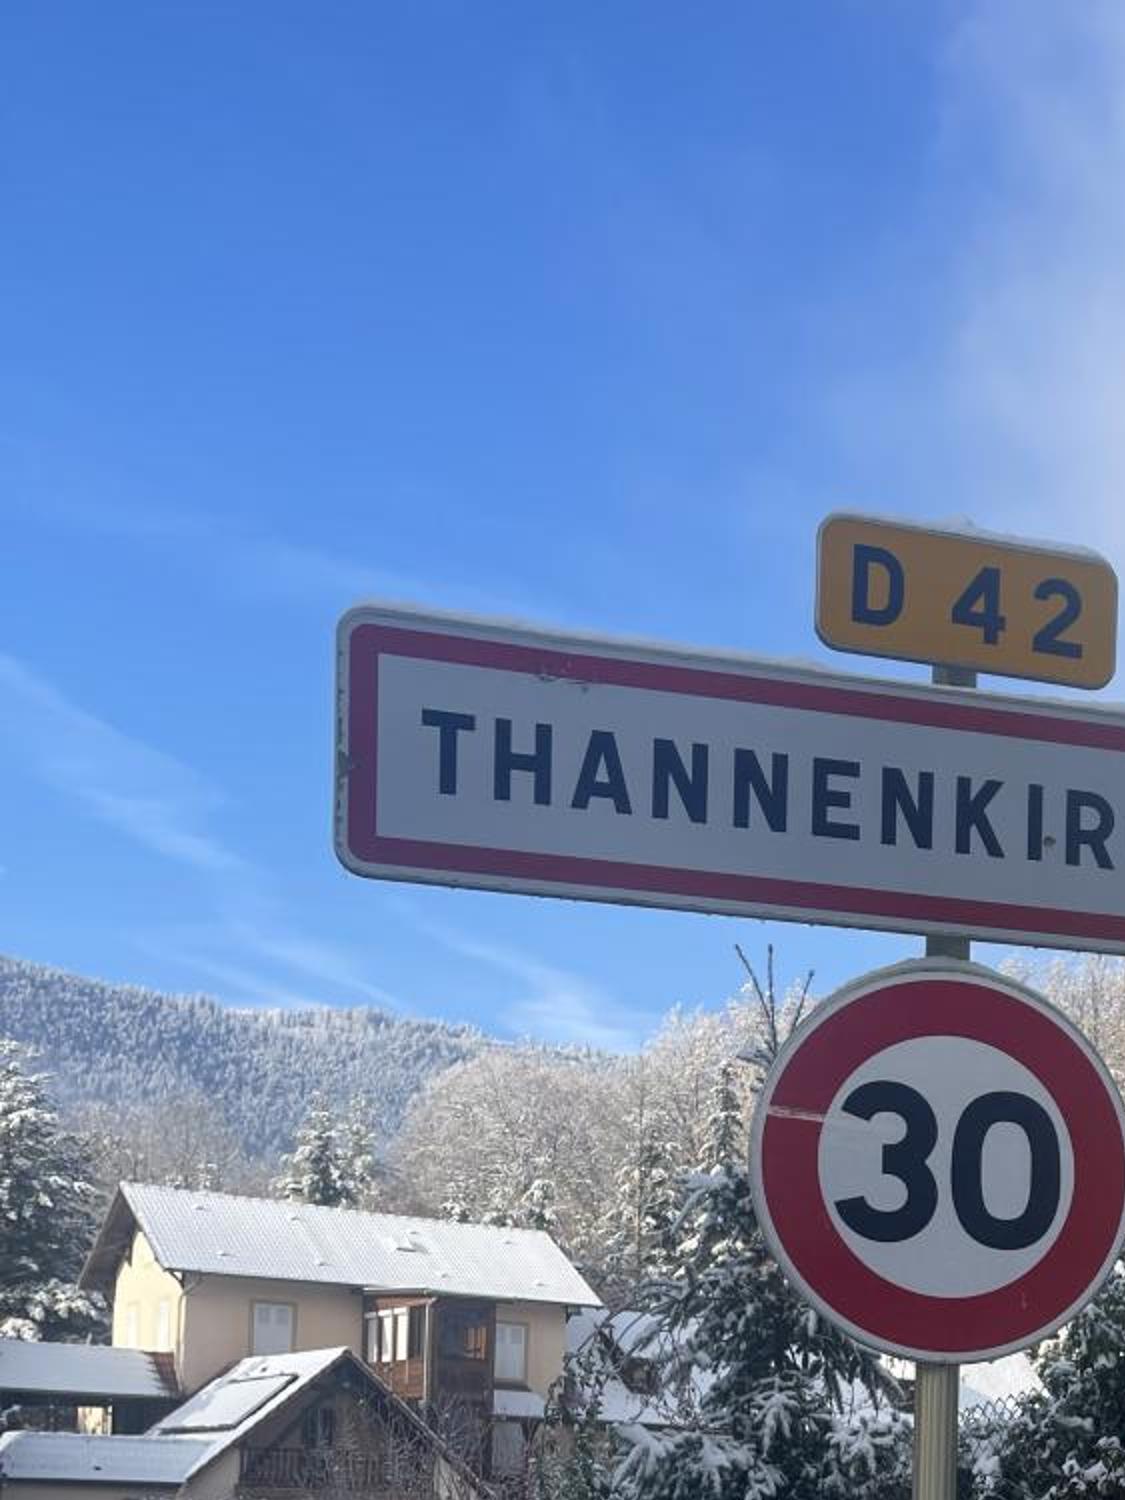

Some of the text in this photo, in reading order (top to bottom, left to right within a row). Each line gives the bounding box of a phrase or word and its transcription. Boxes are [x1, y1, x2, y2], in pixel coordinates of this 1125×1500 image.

[852, 543, 1084, 659] D 42
[833, 1079, 1061, 1251] 30
